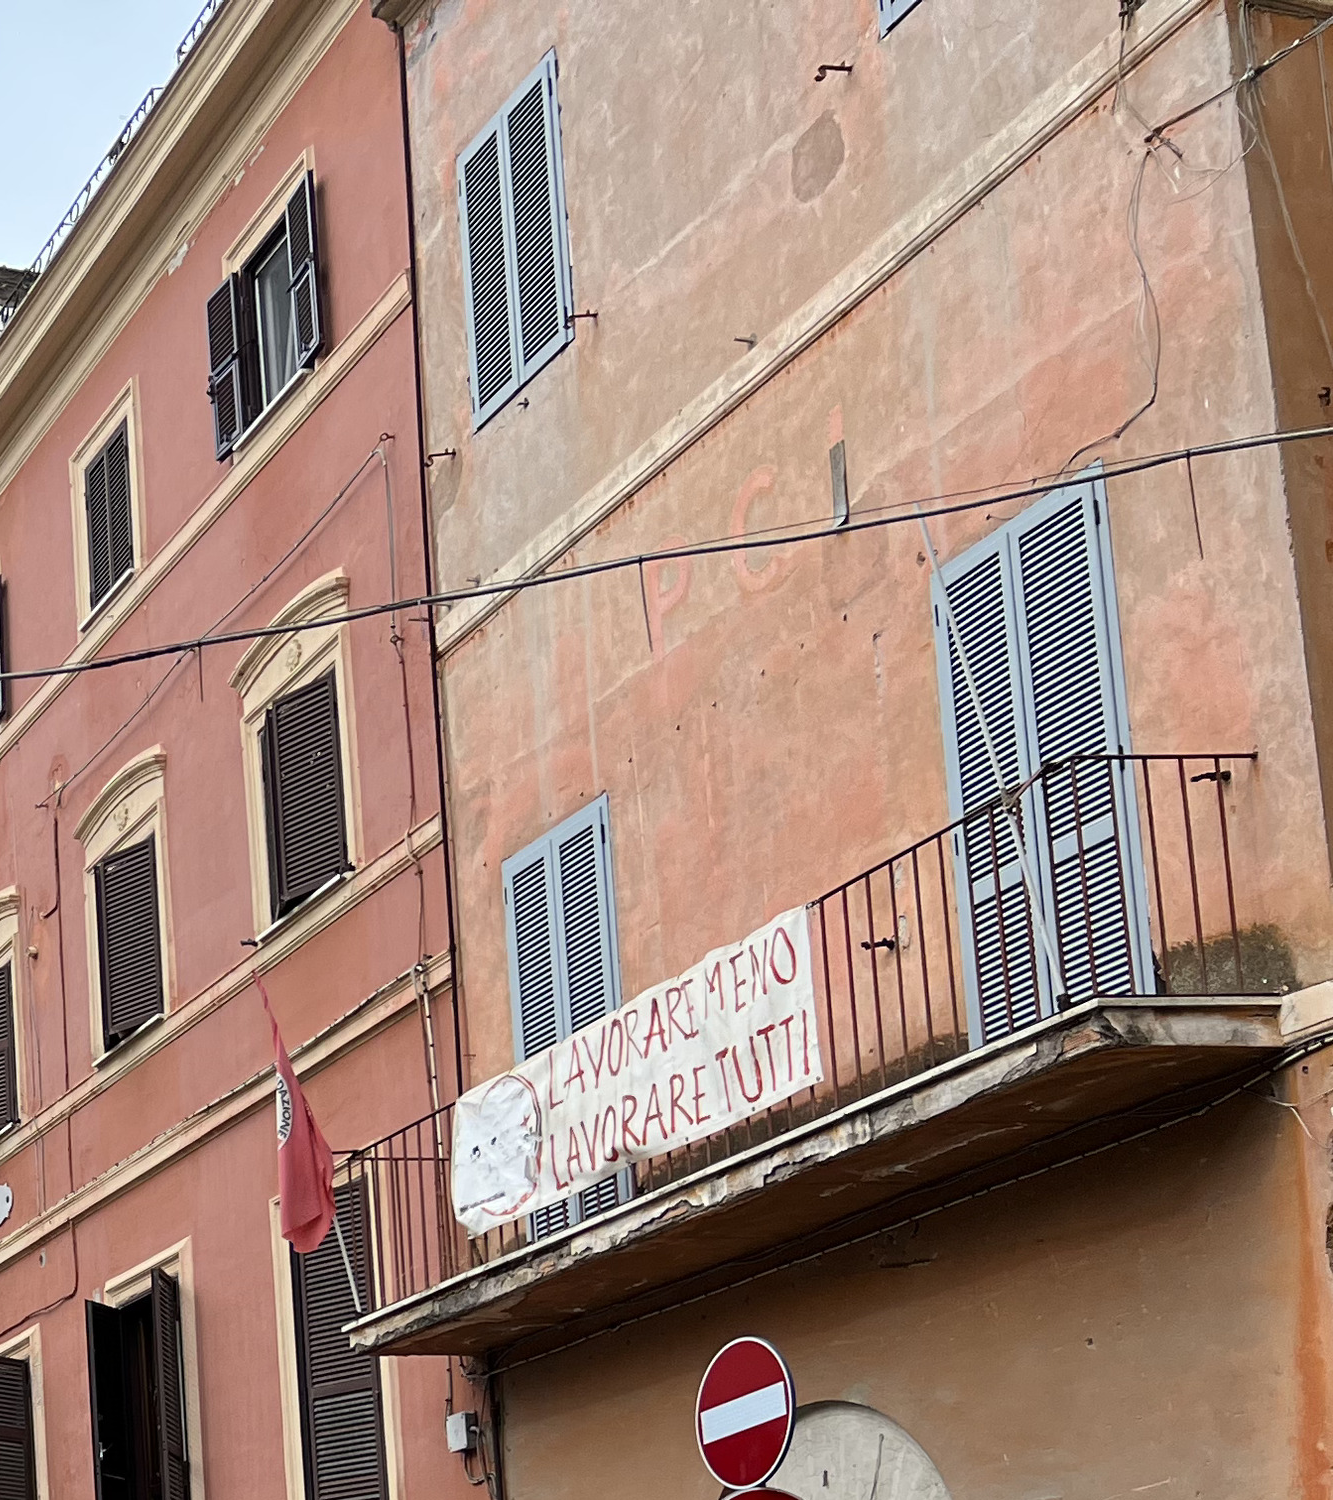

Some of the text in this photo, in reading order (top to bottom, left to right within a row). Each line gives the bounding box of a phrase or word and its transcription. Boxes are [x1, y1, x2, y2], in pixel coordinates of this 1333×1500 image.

[276, 1076, 291, 1138] DAZIONE
[548, 926, 797, 1110] LAVORARE MENO
[550, 1009, 810, 1191] LAVORARE TUTTI
